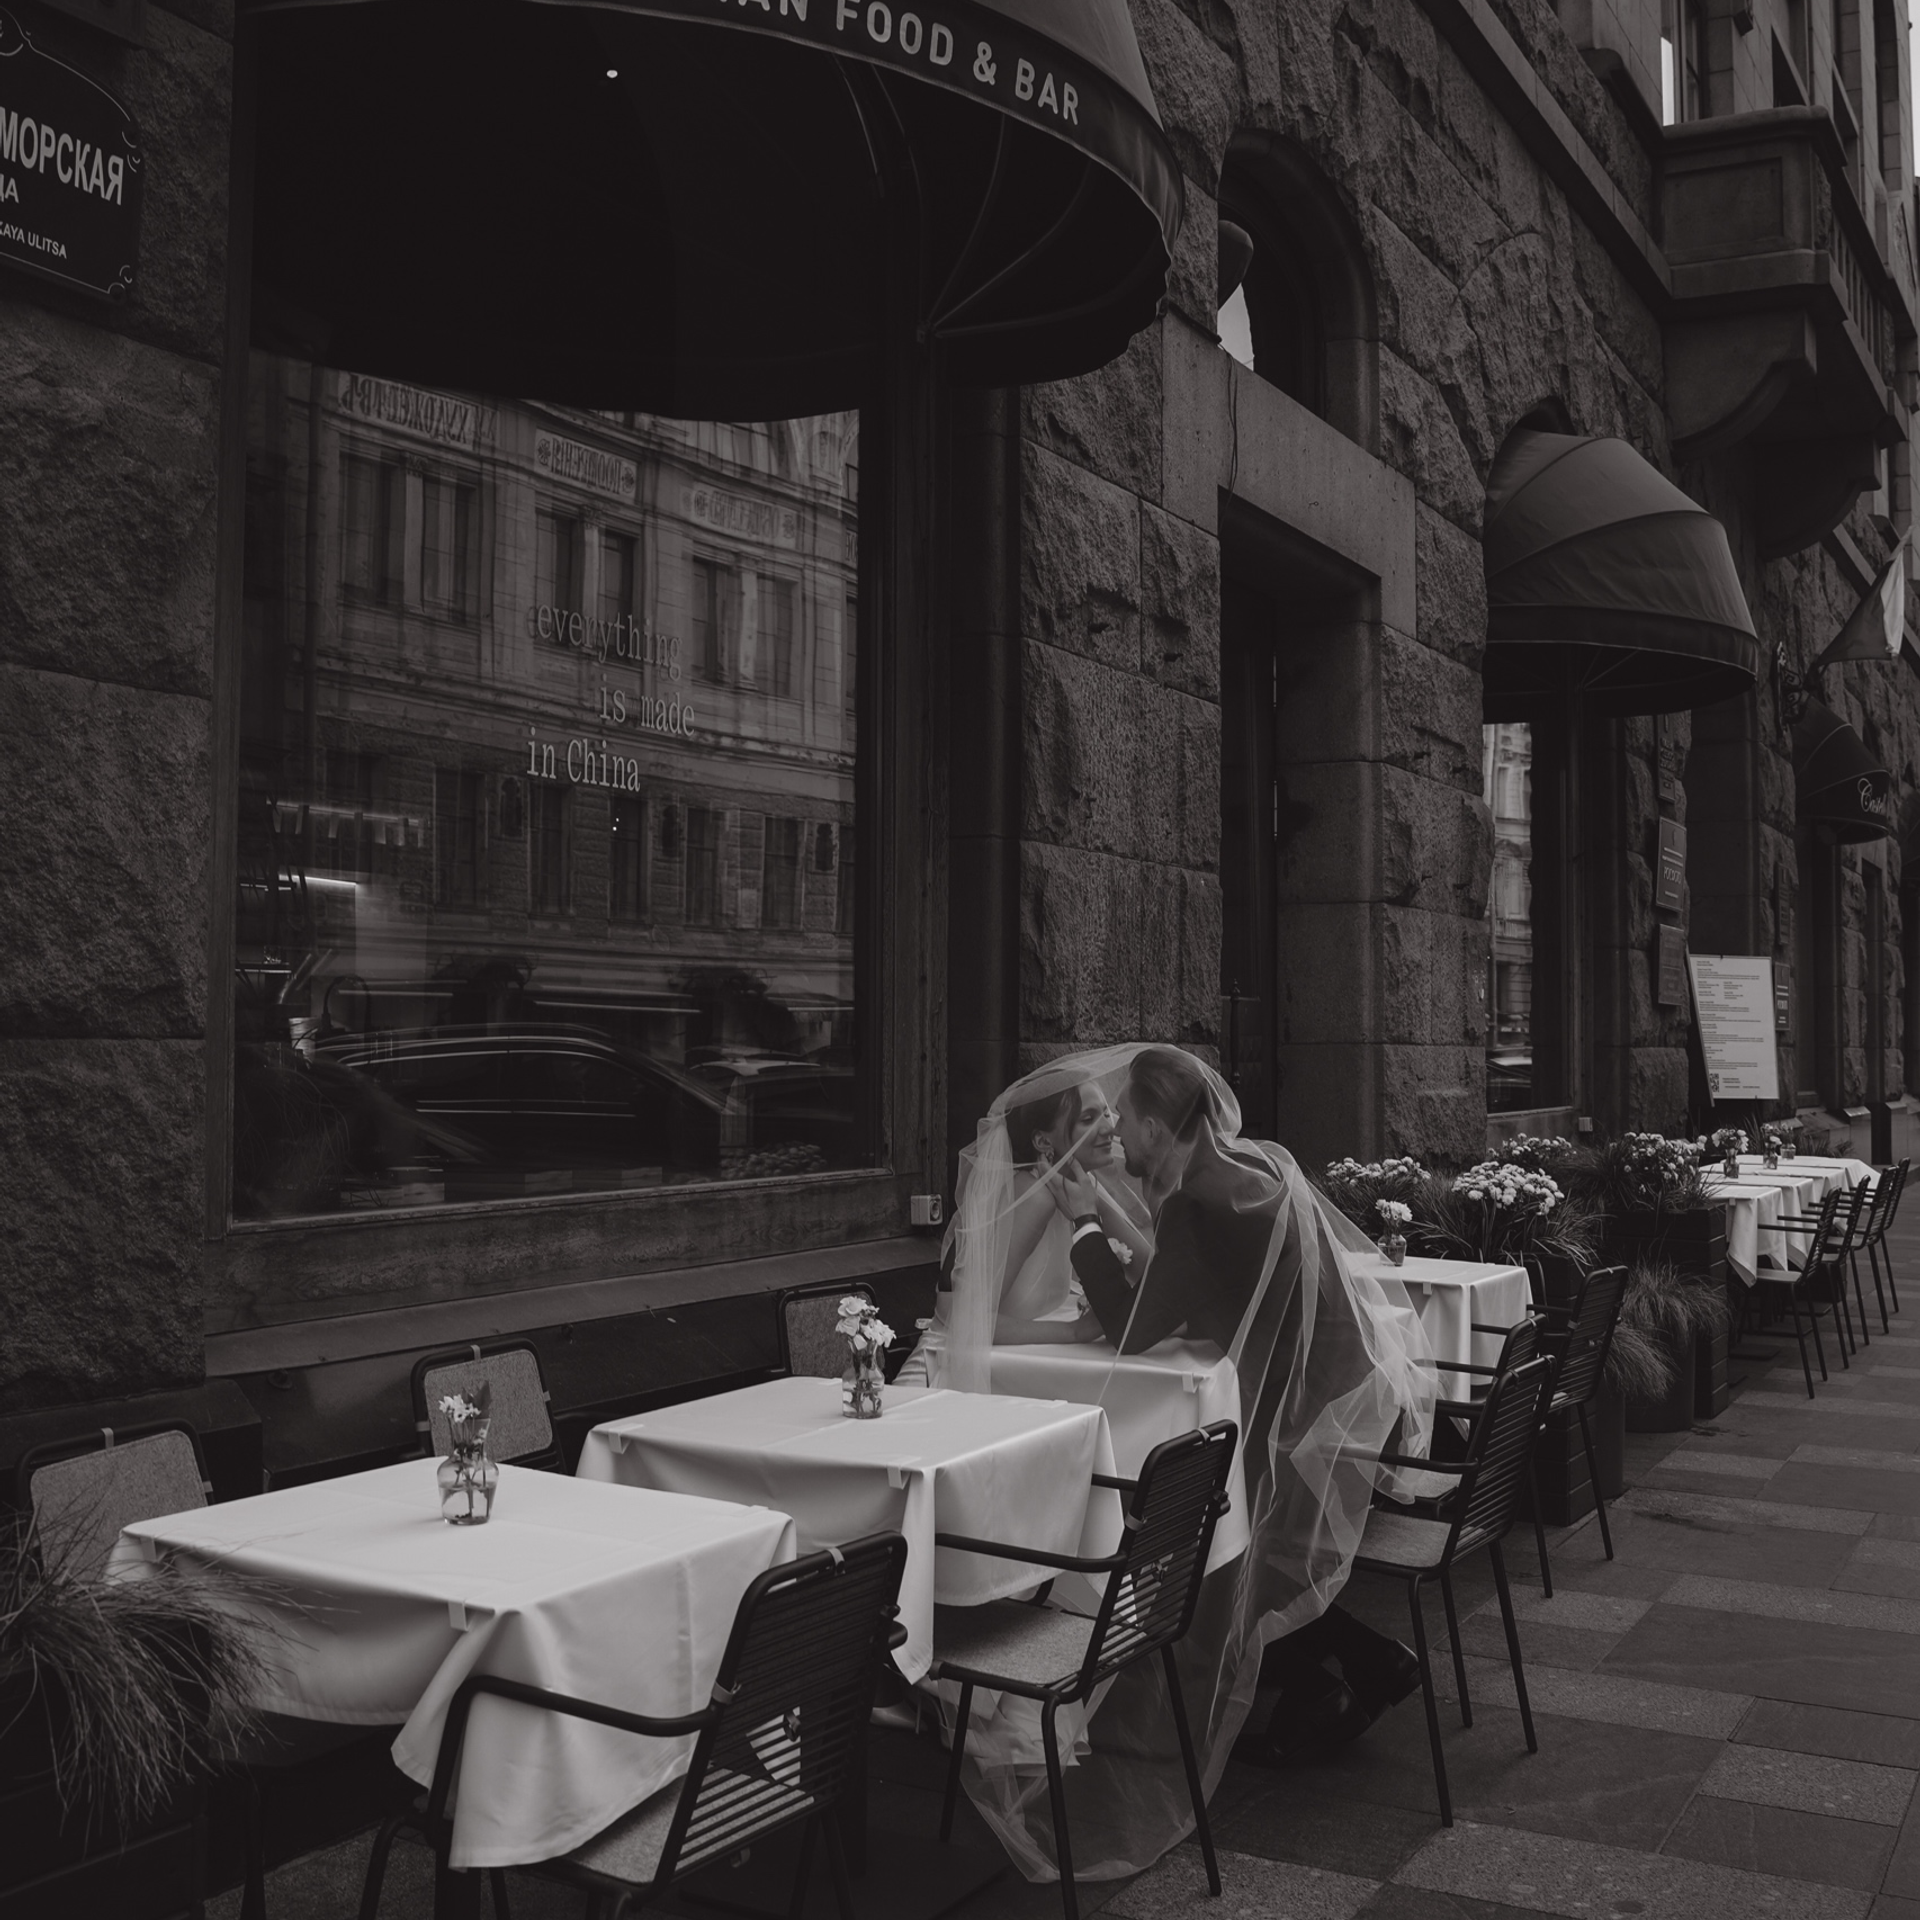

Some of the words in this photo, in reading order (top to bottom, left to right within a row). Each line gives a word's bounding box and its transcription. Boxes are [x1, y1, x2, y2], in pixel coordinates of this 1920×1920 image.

[836, 0, 954, 66] FOOD
[973, 41, 997, 86] &
[1014, 57, 1079, 126] BAR
[28, 231, 68, 259] ULITSA
[537, 603, 682, 682] everything
[599, 673, 626, 724] is
[641, 692, 695, 737] made
[526, 726, 557, 780] in
[567, 737, 641, 793] China
